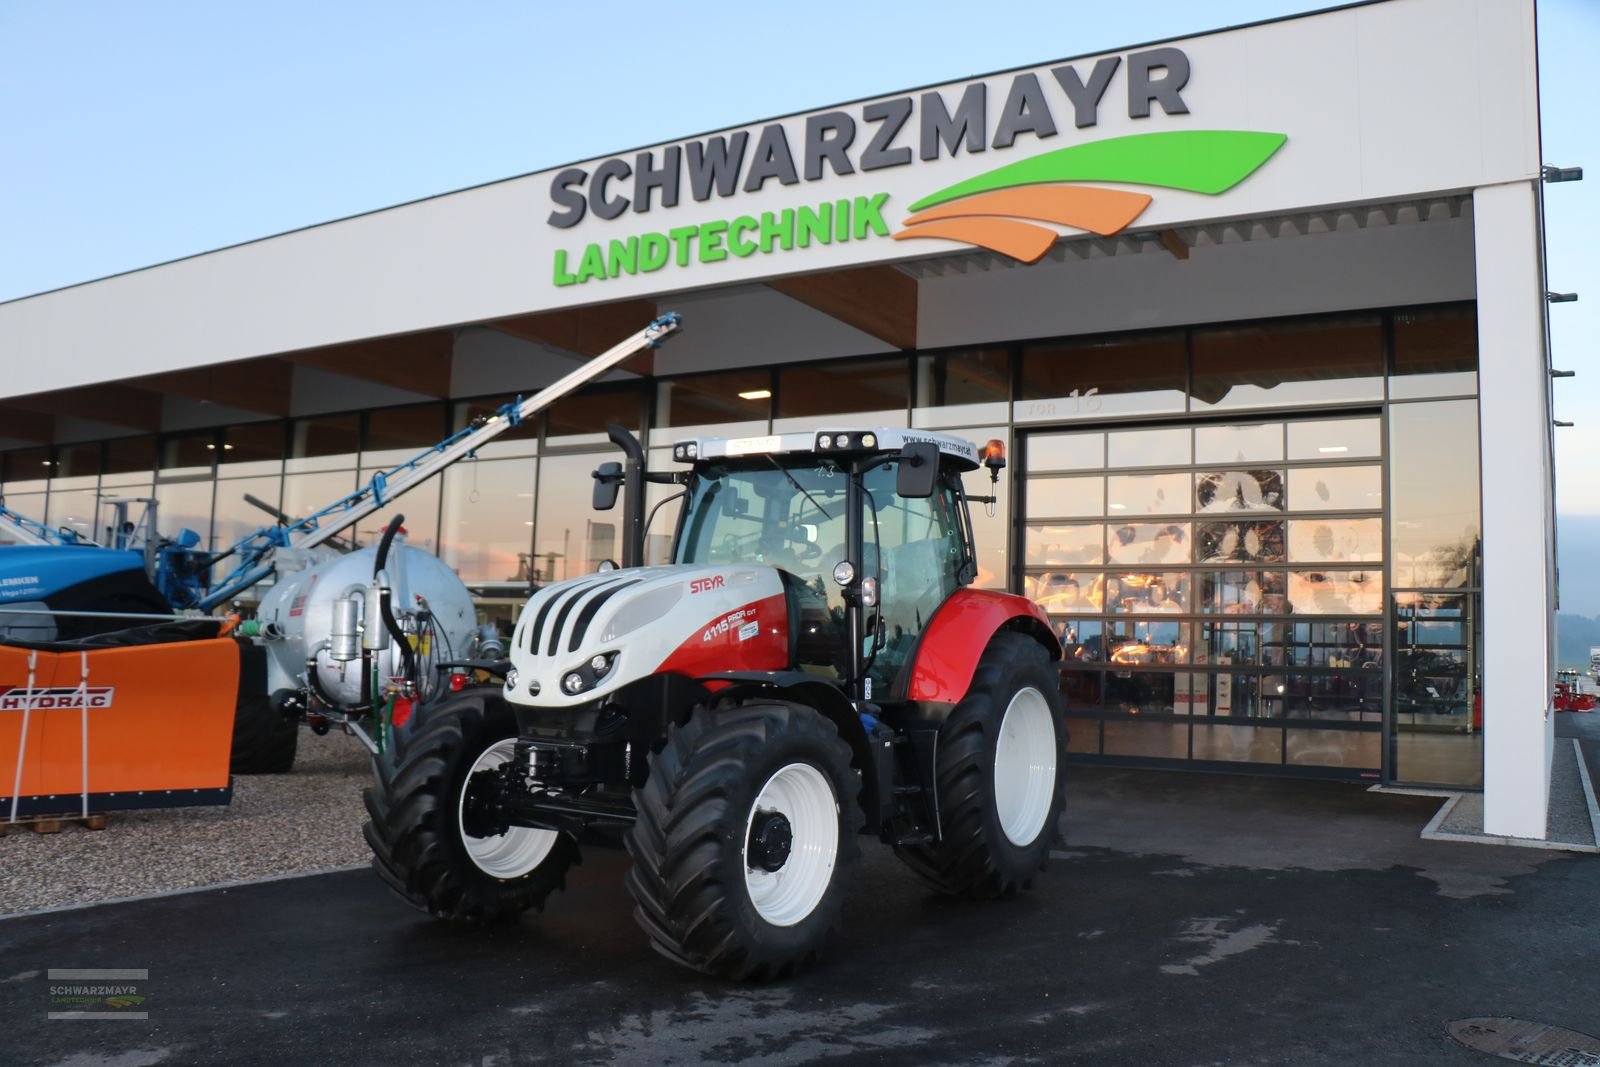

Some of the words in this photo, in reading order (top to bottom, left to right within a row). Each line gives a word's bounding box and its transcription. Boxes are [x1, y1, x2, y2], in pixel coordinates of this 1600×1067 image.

[547, 47, 1190, 229] SCHWARZMAYR
[553, 193, 891, 287] LANDTECHNIK
[1069, 387, 1102, 415] 16
[690, 575, 725, 594] STEYR
[703, 619, 729, 642] 4115
[1, 696, 105, 708] HYDRAC
